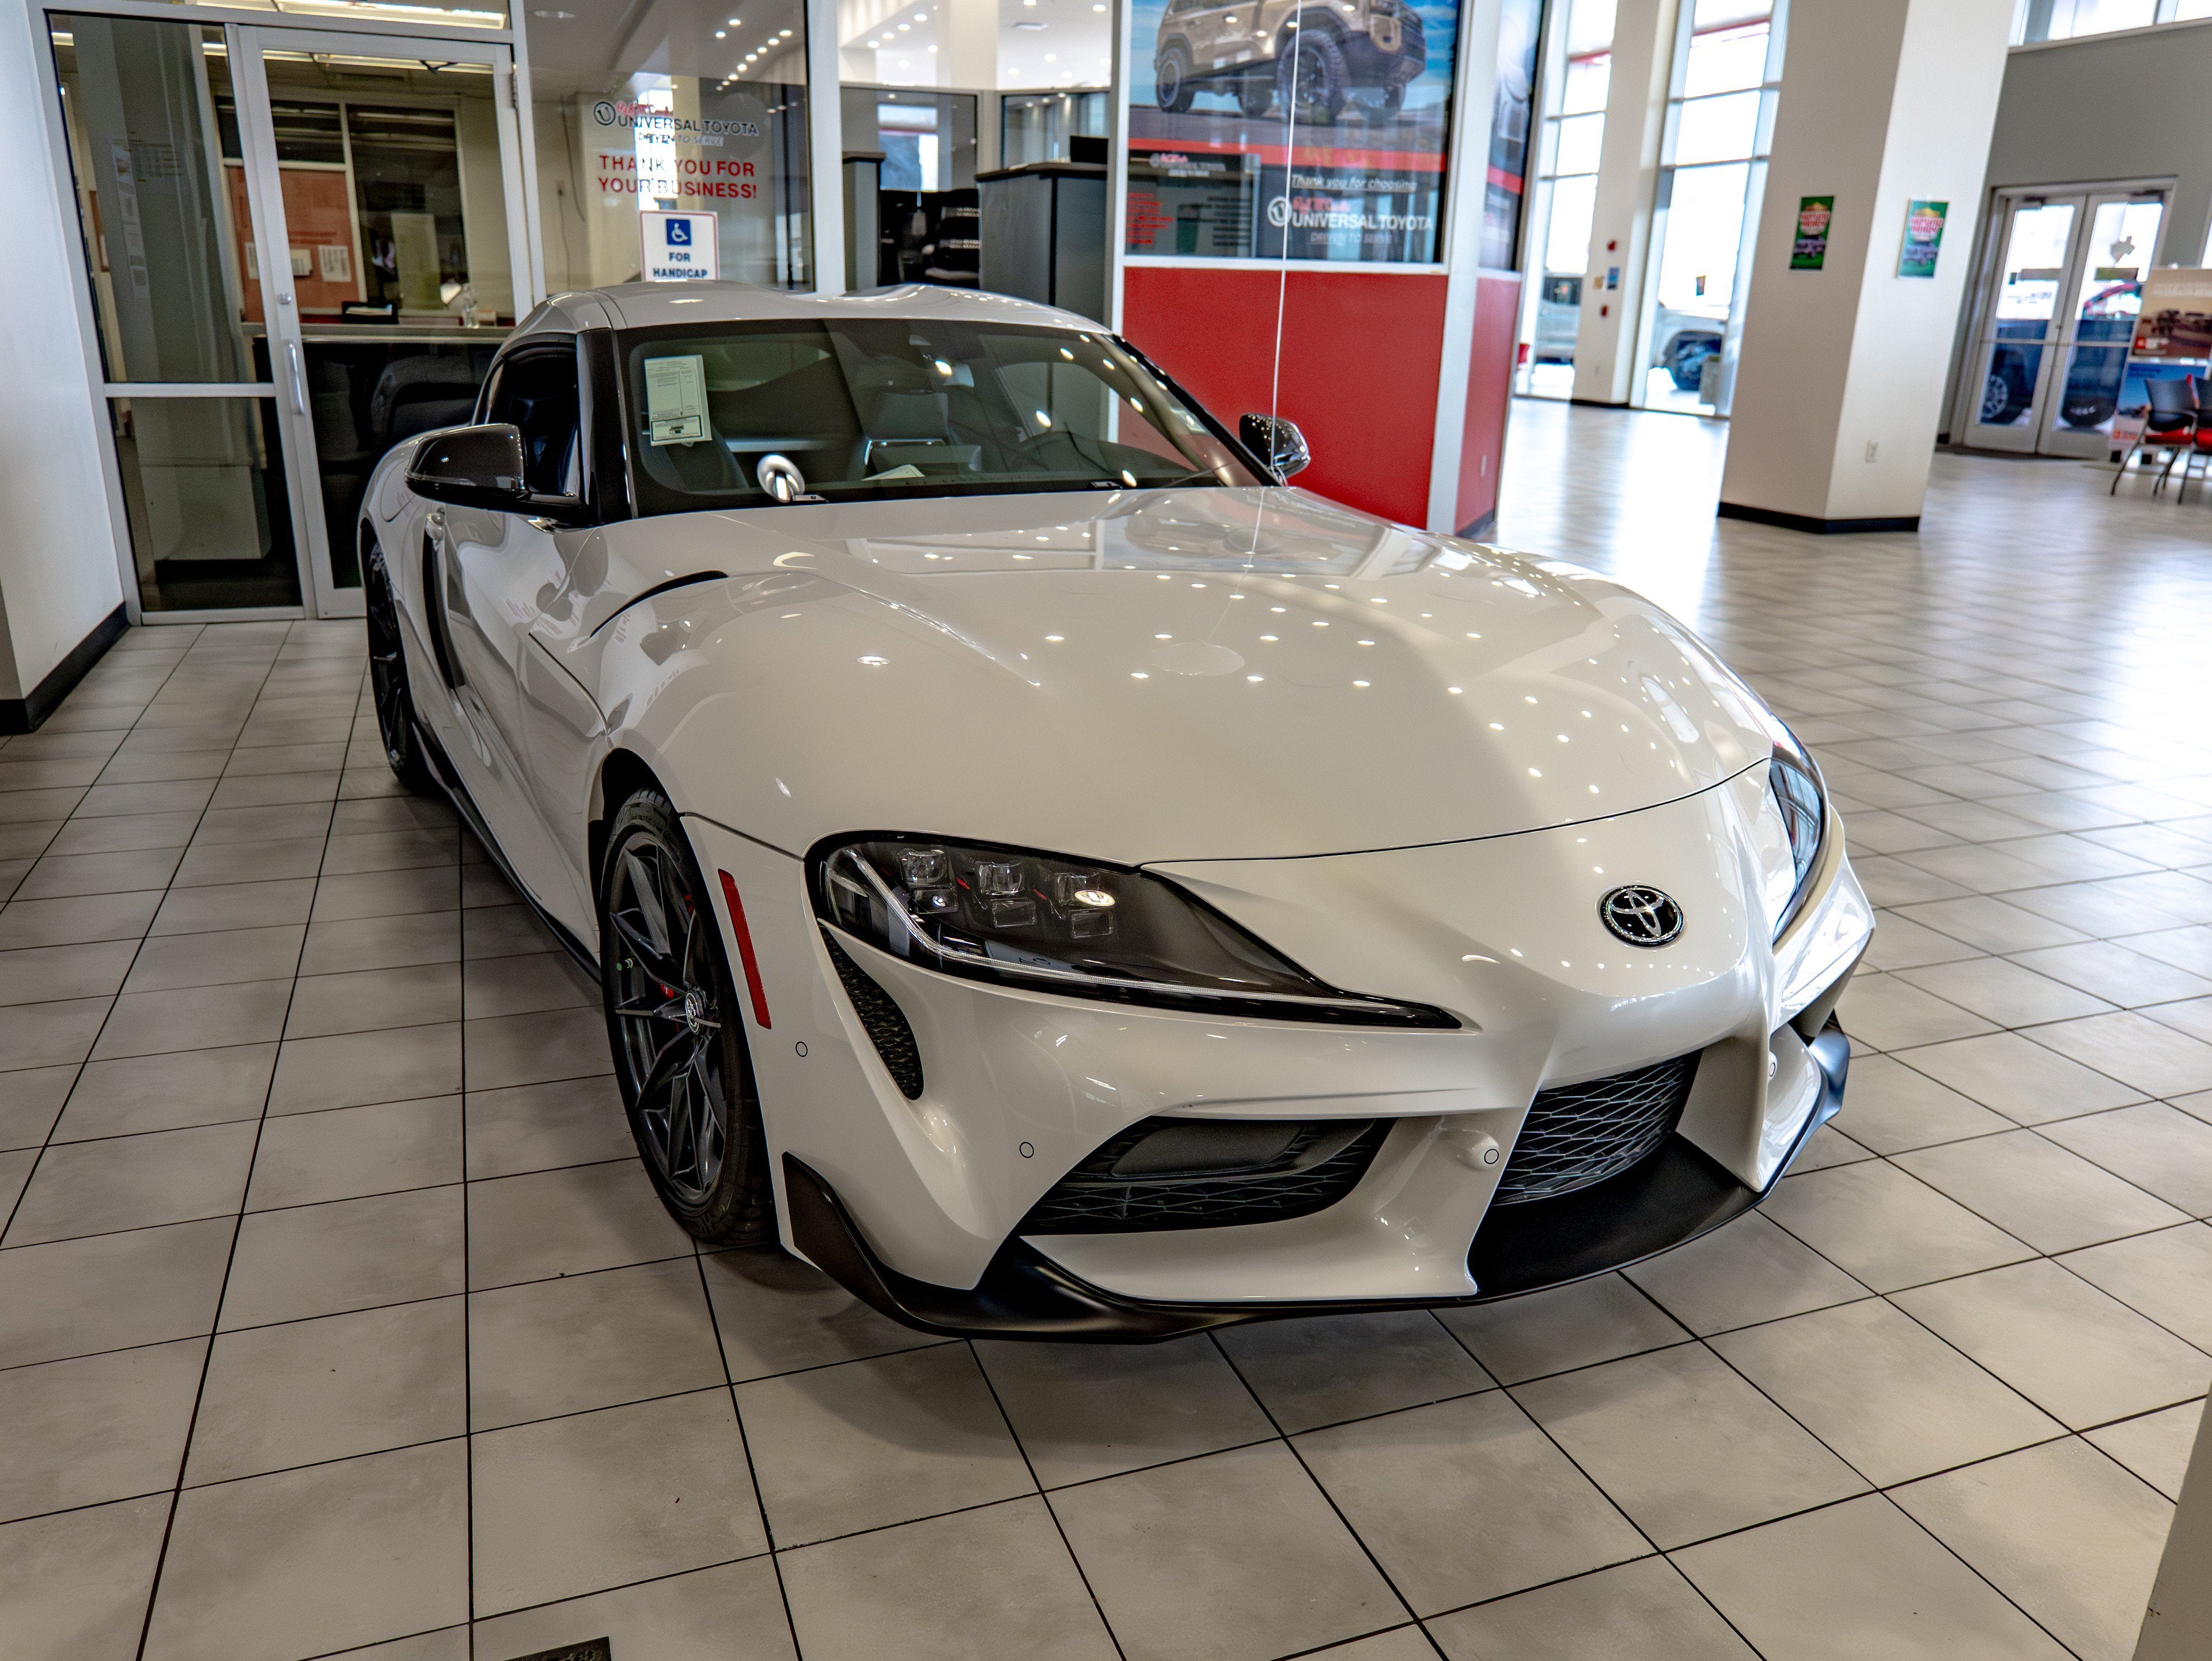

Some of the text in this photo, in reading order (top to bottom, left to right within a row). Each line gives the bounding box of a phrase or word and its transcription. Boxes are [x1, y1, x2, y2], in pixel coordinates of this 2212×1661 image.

[619, 116, 759, 136] UNIVERSAL TOYOTA
[599, 155, 755, 176] THANK YOU FOR
[598, 177, 757, 199] YOUR BUSINESS!
[1291, 211, 1434, 230] UNIVERSAL TOYOTA
[668, 252, 691, 262] FOR
[653, 268, 707, 278] HANDICAP
